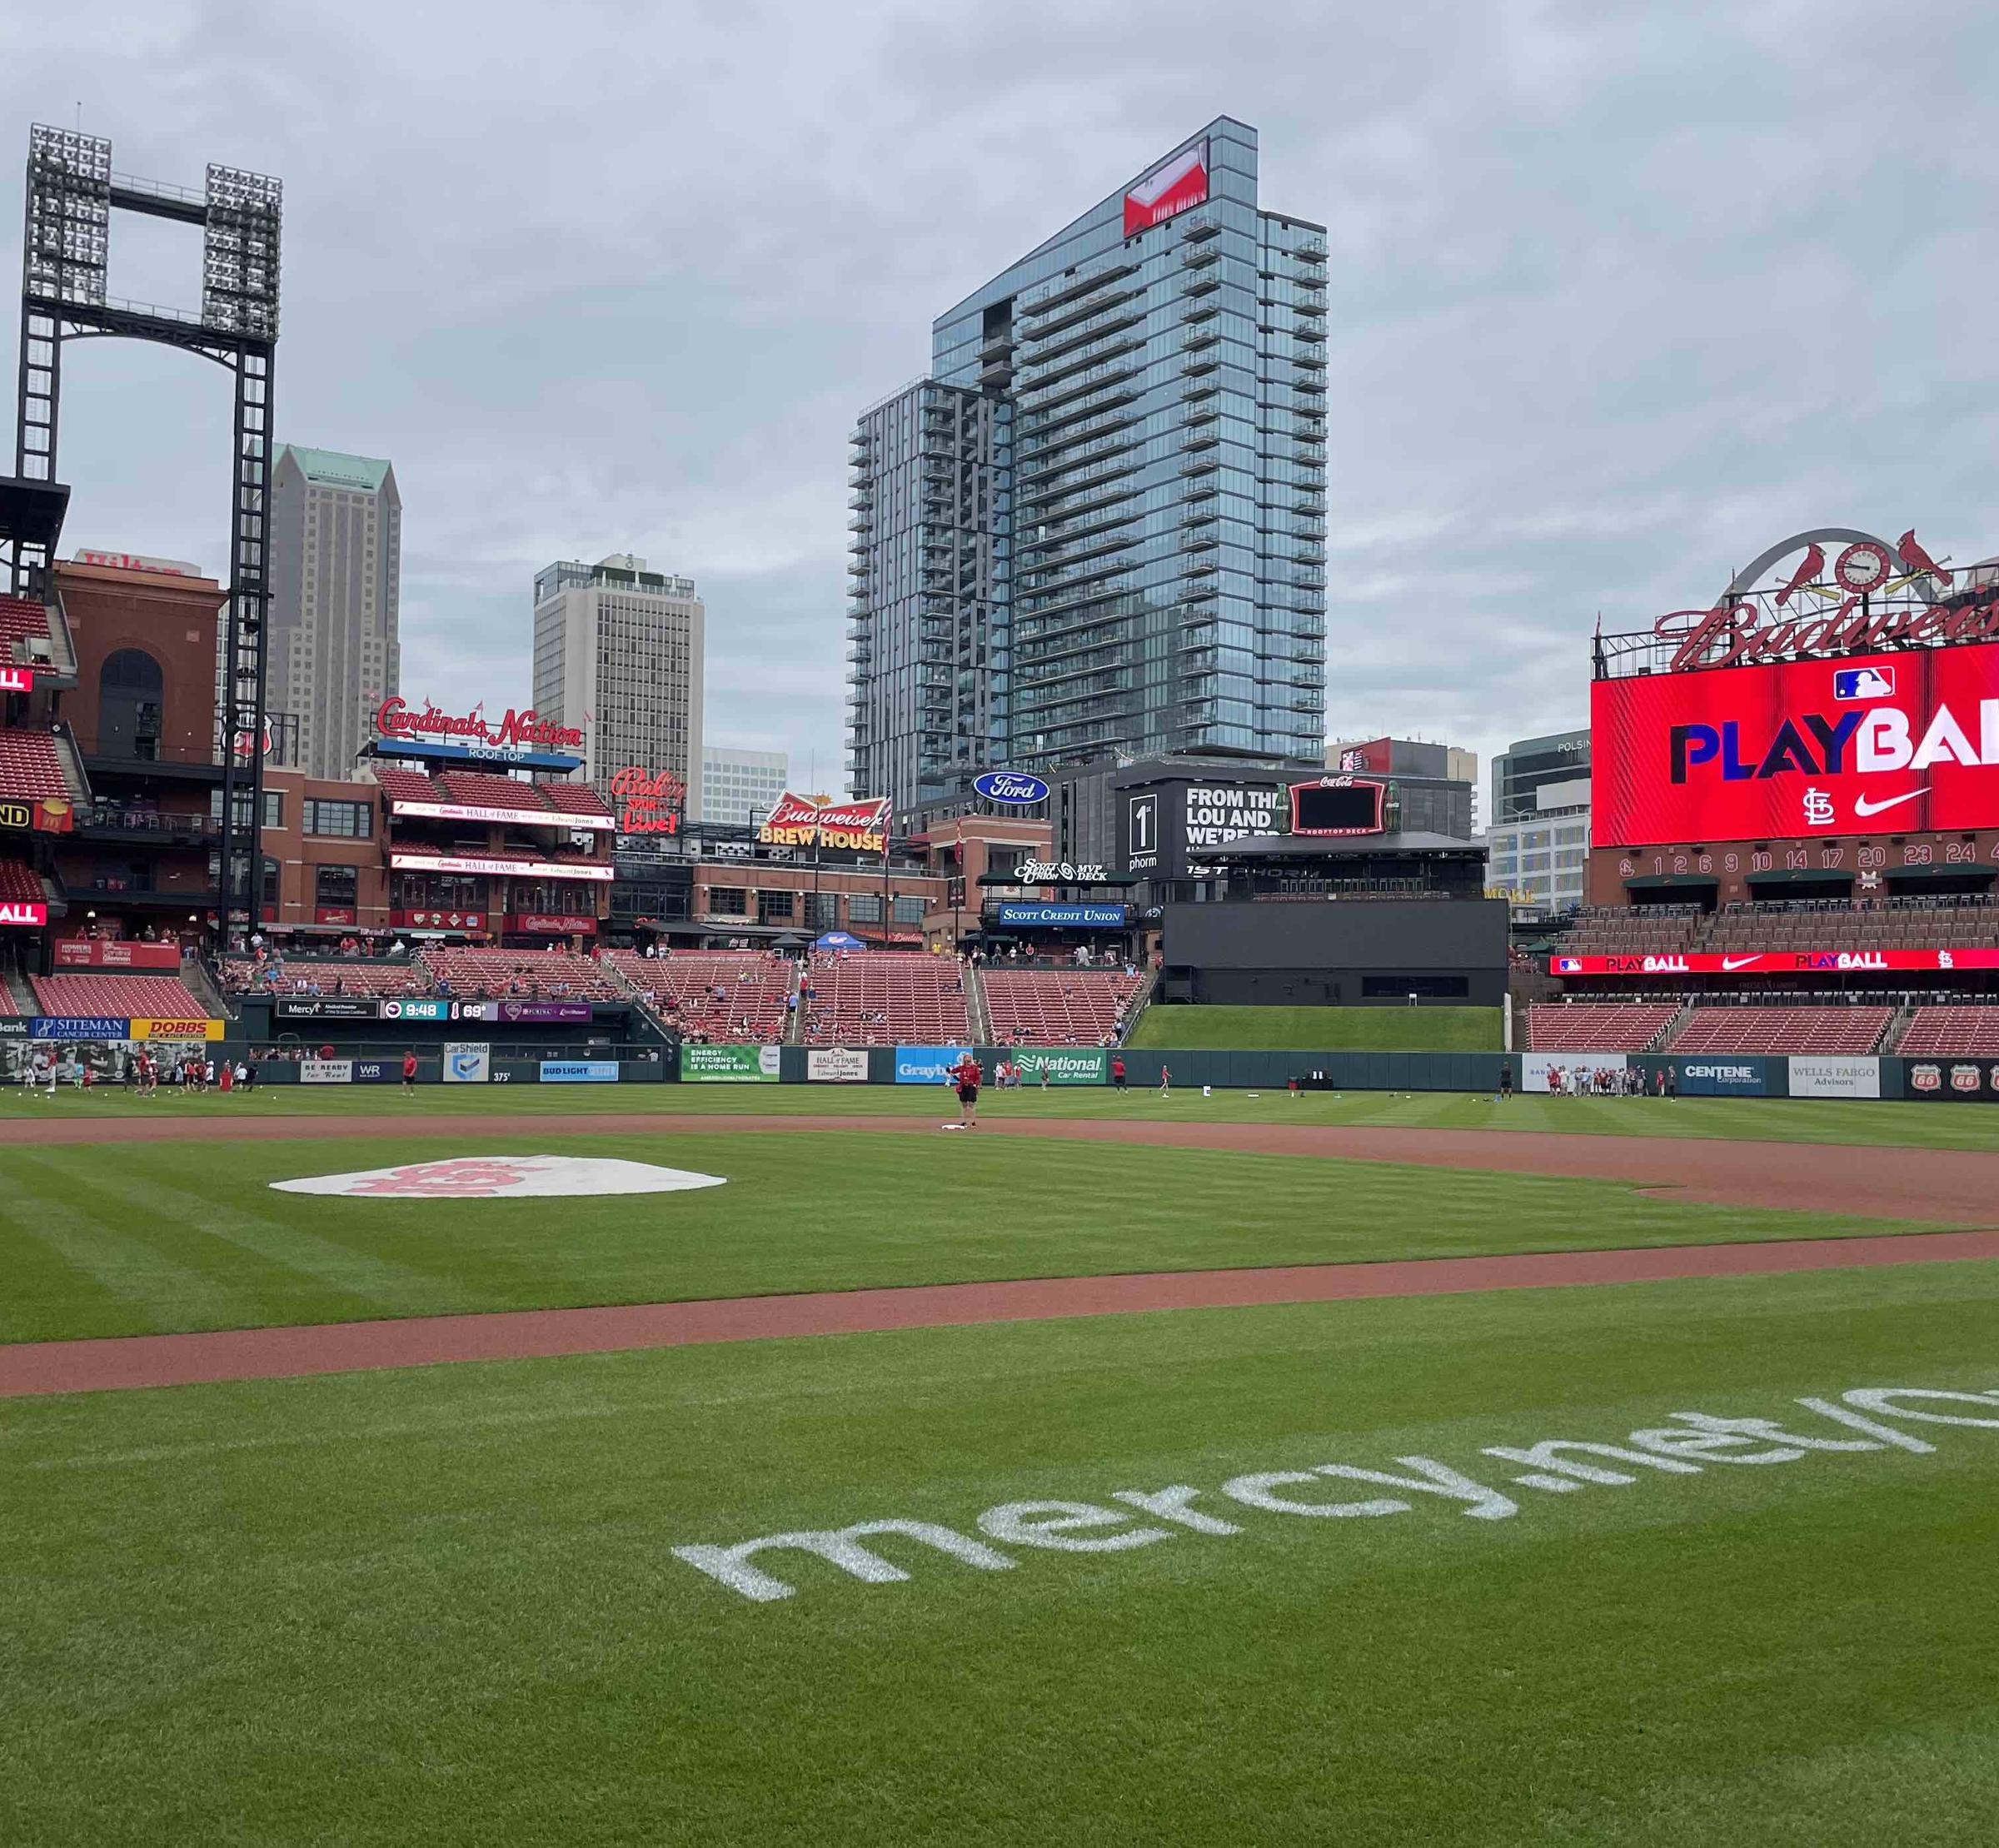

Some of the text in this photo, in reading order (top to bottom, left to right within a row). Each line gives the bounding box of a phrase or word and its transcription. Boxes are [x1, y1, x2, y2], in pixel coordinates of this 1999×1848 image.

[85, 552, 181, 575] Hilt
[376, 696, 583, 747] Cardinals Nation
[467, 748, 526, 763] ROOFTOP
[990, 775, 1035, 799] Ford
[1187, 788, 1244, 808] FROM
[466, 809, 490, 818] HALL
[496, 811, 519, 820] FAME
[761, 801, 883, 827] Budweiser
[1187, 807, 1272, 828] LOU AND
[624, 811, 676, 834] Live!
[760, 825, 884, 851] BREW HOUSE
[1185, 826, 1249, 844] WE'RE
[1025, 858, 1059, 871] SCOTT
[1129, 856, 1157, 873] phorm
[1654, 856, 1663, 875] 1
[1674, 855, 1687, 874] 2
[1698, 854, 1712, 874] 6
[1725, 853, 1738, 873] 9
[1752, 852, 1772, 872] 10
[1786, 849, 1807, 869] 14
[1821, 848, 1843, 869] 17
[1858, 846, 1886, 868] 20
[1904, 844, 1932, 865] 23
[1946, 842, 1976, 864] 24
[465, 862, 486, 870] HALL
[495, 864, 517, 872] FAME
[1076, 864, 1103, 873] MVP
[1186, 865, 1229, 875] 1ST
[1076, 872, 1108, 881] DECK
[1004, 909, 1121, 921] SCOTT CREDIT UNION
[288, 1004, 315, 1015] Mercy
[57, 1019, 123, 1031] SITEMAN
[151, 1022, 207, 1033] DOBBS
[445, 1043, 488, 1054] CarShield
[1034, 1056, 1101, 1071] National
[562, 1067, 589, 1075] LIGHT
[1685, 1065, 1753, 1078] CENTENE
[1792, 1068, 1875, 1078] WELLS FARGO
[1717, 1076, 1762, 1086] Corporation
[1814, 1078, 1854, 1087] Advisors
[1917, 1075, 1934, 1085] 66
[1956, 1075, 1974, 1086] 66
